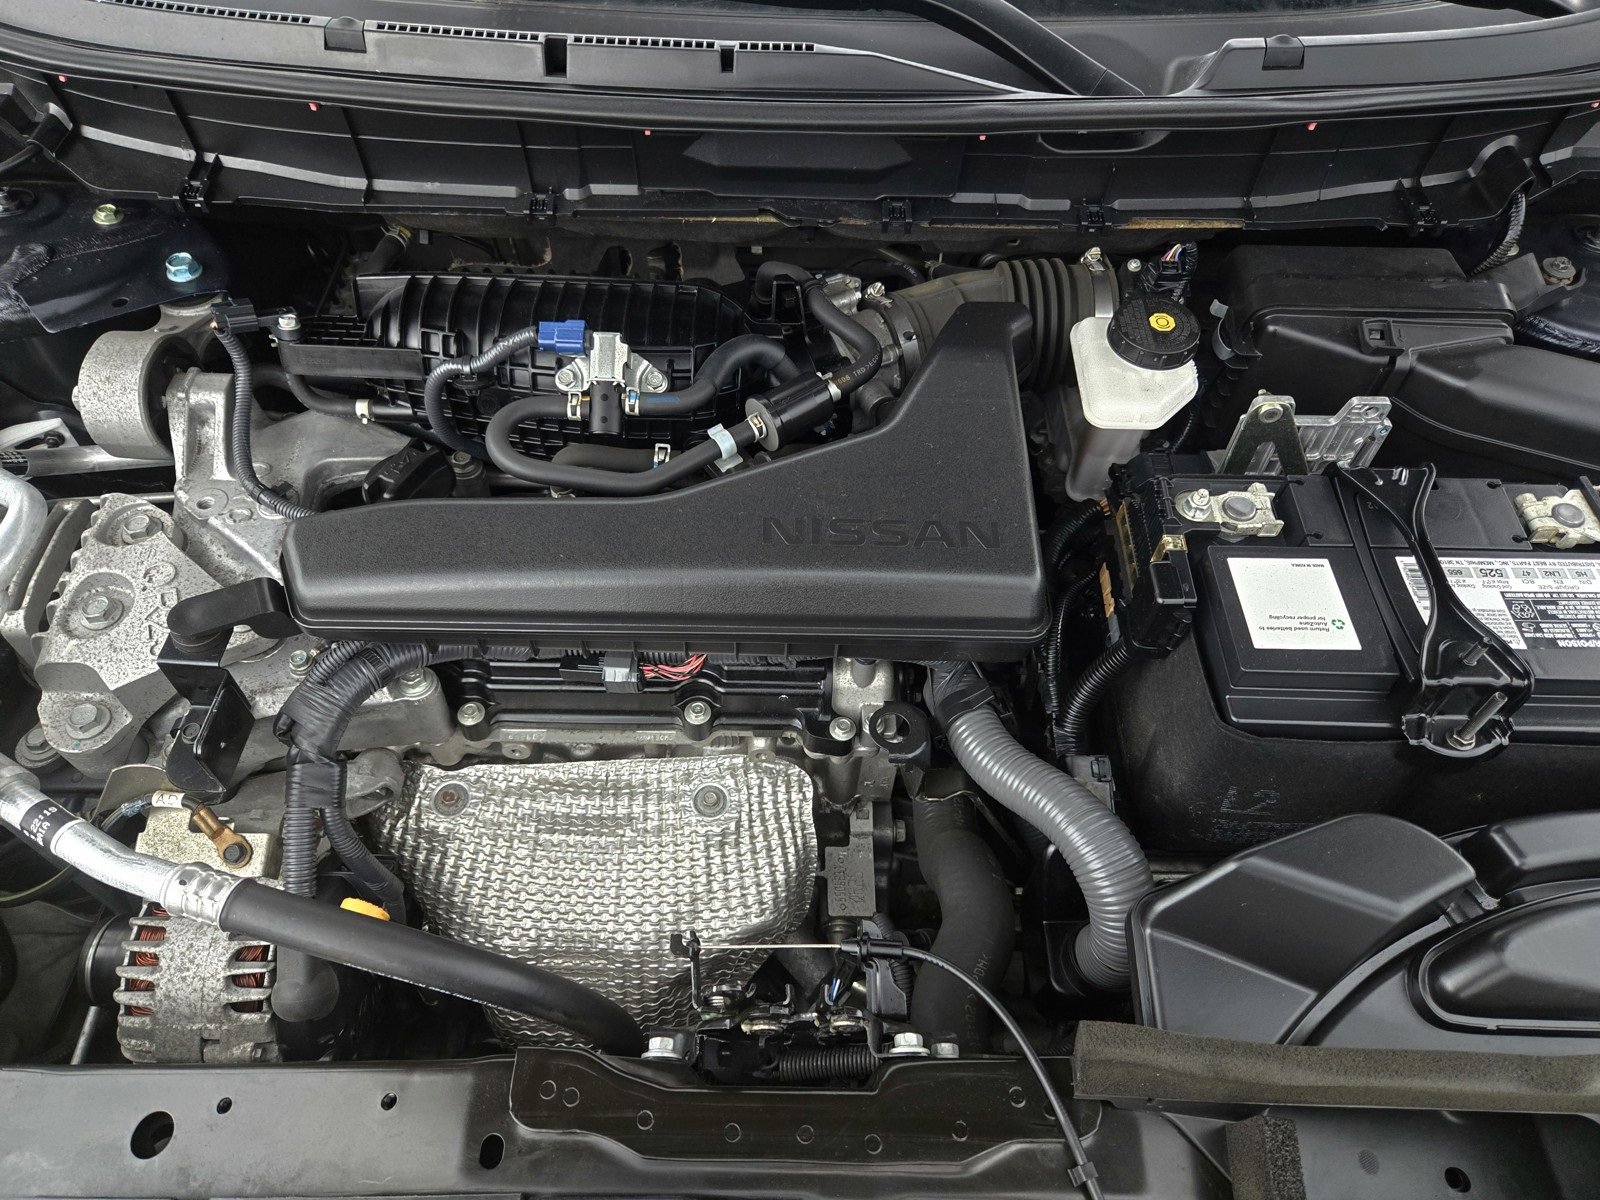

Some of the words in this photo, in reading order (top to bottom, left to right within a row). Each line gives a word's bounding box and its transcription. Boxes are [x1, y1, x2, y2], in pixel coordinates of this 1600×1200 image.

[761, 517, 1001, 549] NISSAN
[1447, 568, 1463, 576] 655
[1479, 568, 1503, 578] 525
